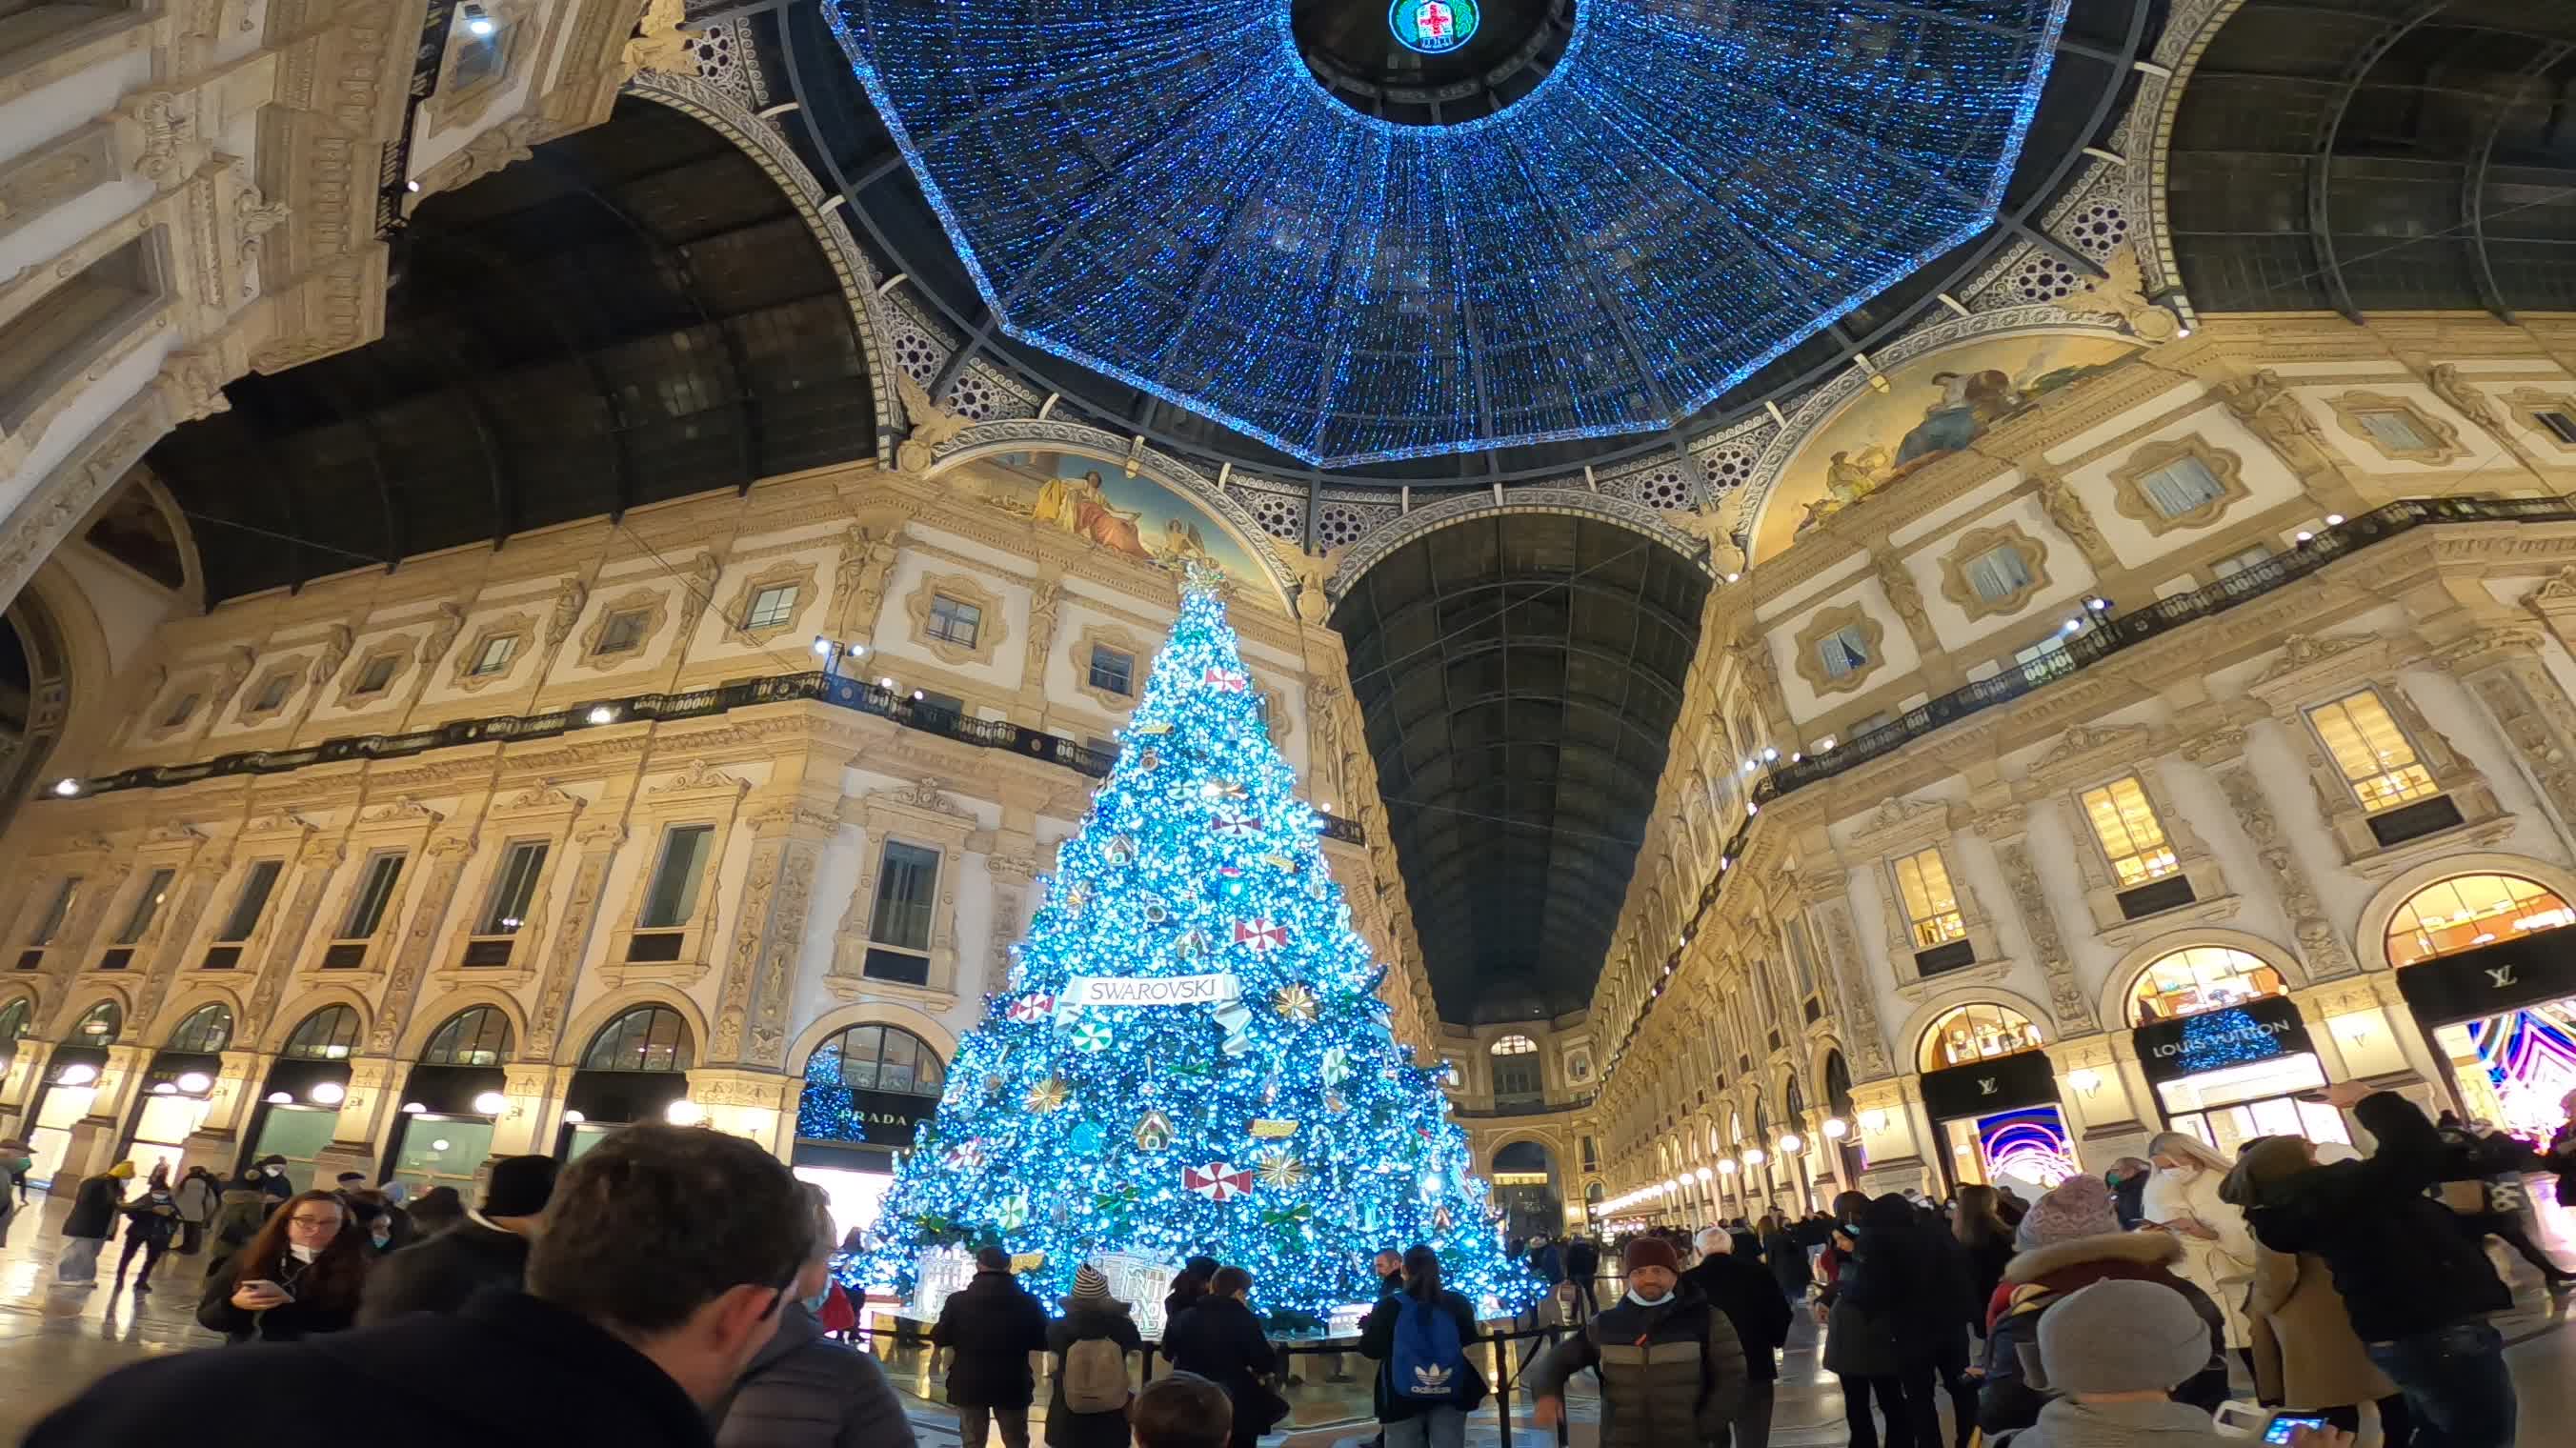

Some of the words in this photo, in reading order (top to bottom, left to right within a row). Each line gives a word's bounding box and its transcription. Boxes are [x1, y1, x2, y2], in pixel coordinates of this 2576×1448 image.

[1090, 978, 1217, 1000] SWAROVSKI
[2152, 1037, 2206, 1058] LOUIS
[2209, 1018, 2291, 1046] VUITTON
[838, 1109, 908, 1126] PRADA
